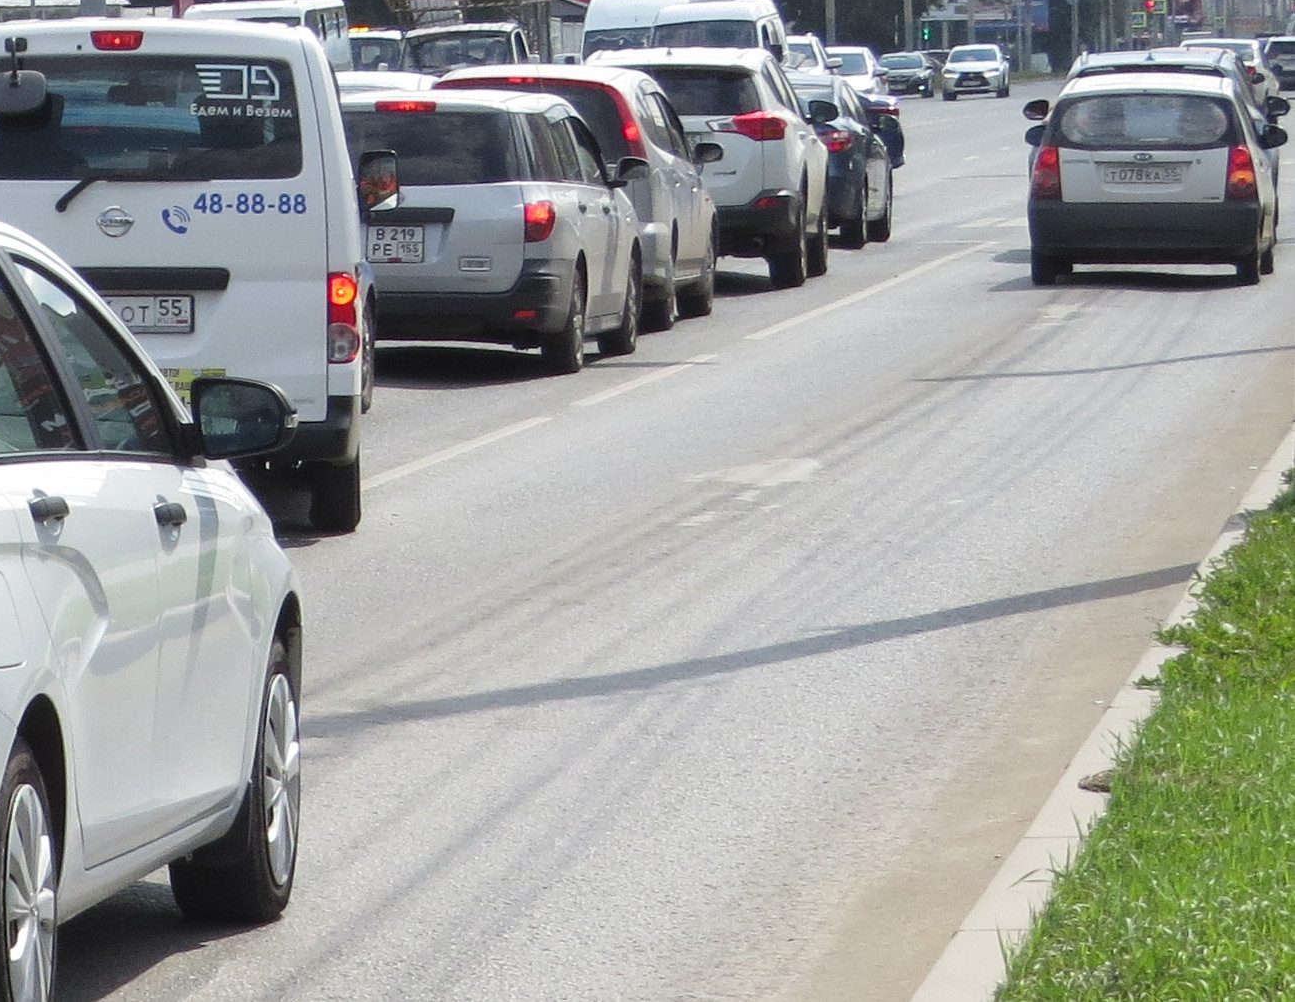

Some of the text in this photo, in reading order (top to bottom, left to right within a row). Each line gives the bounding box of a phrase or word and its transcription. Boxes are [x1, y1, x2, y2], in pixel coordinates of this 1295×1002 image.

[190, 103, 293, 118] Едем и Везем
[193, 193, 307, 214] 48-88-88
[372, 244, 392, 257] РЕ
[159, 299, 182, 317] 55
